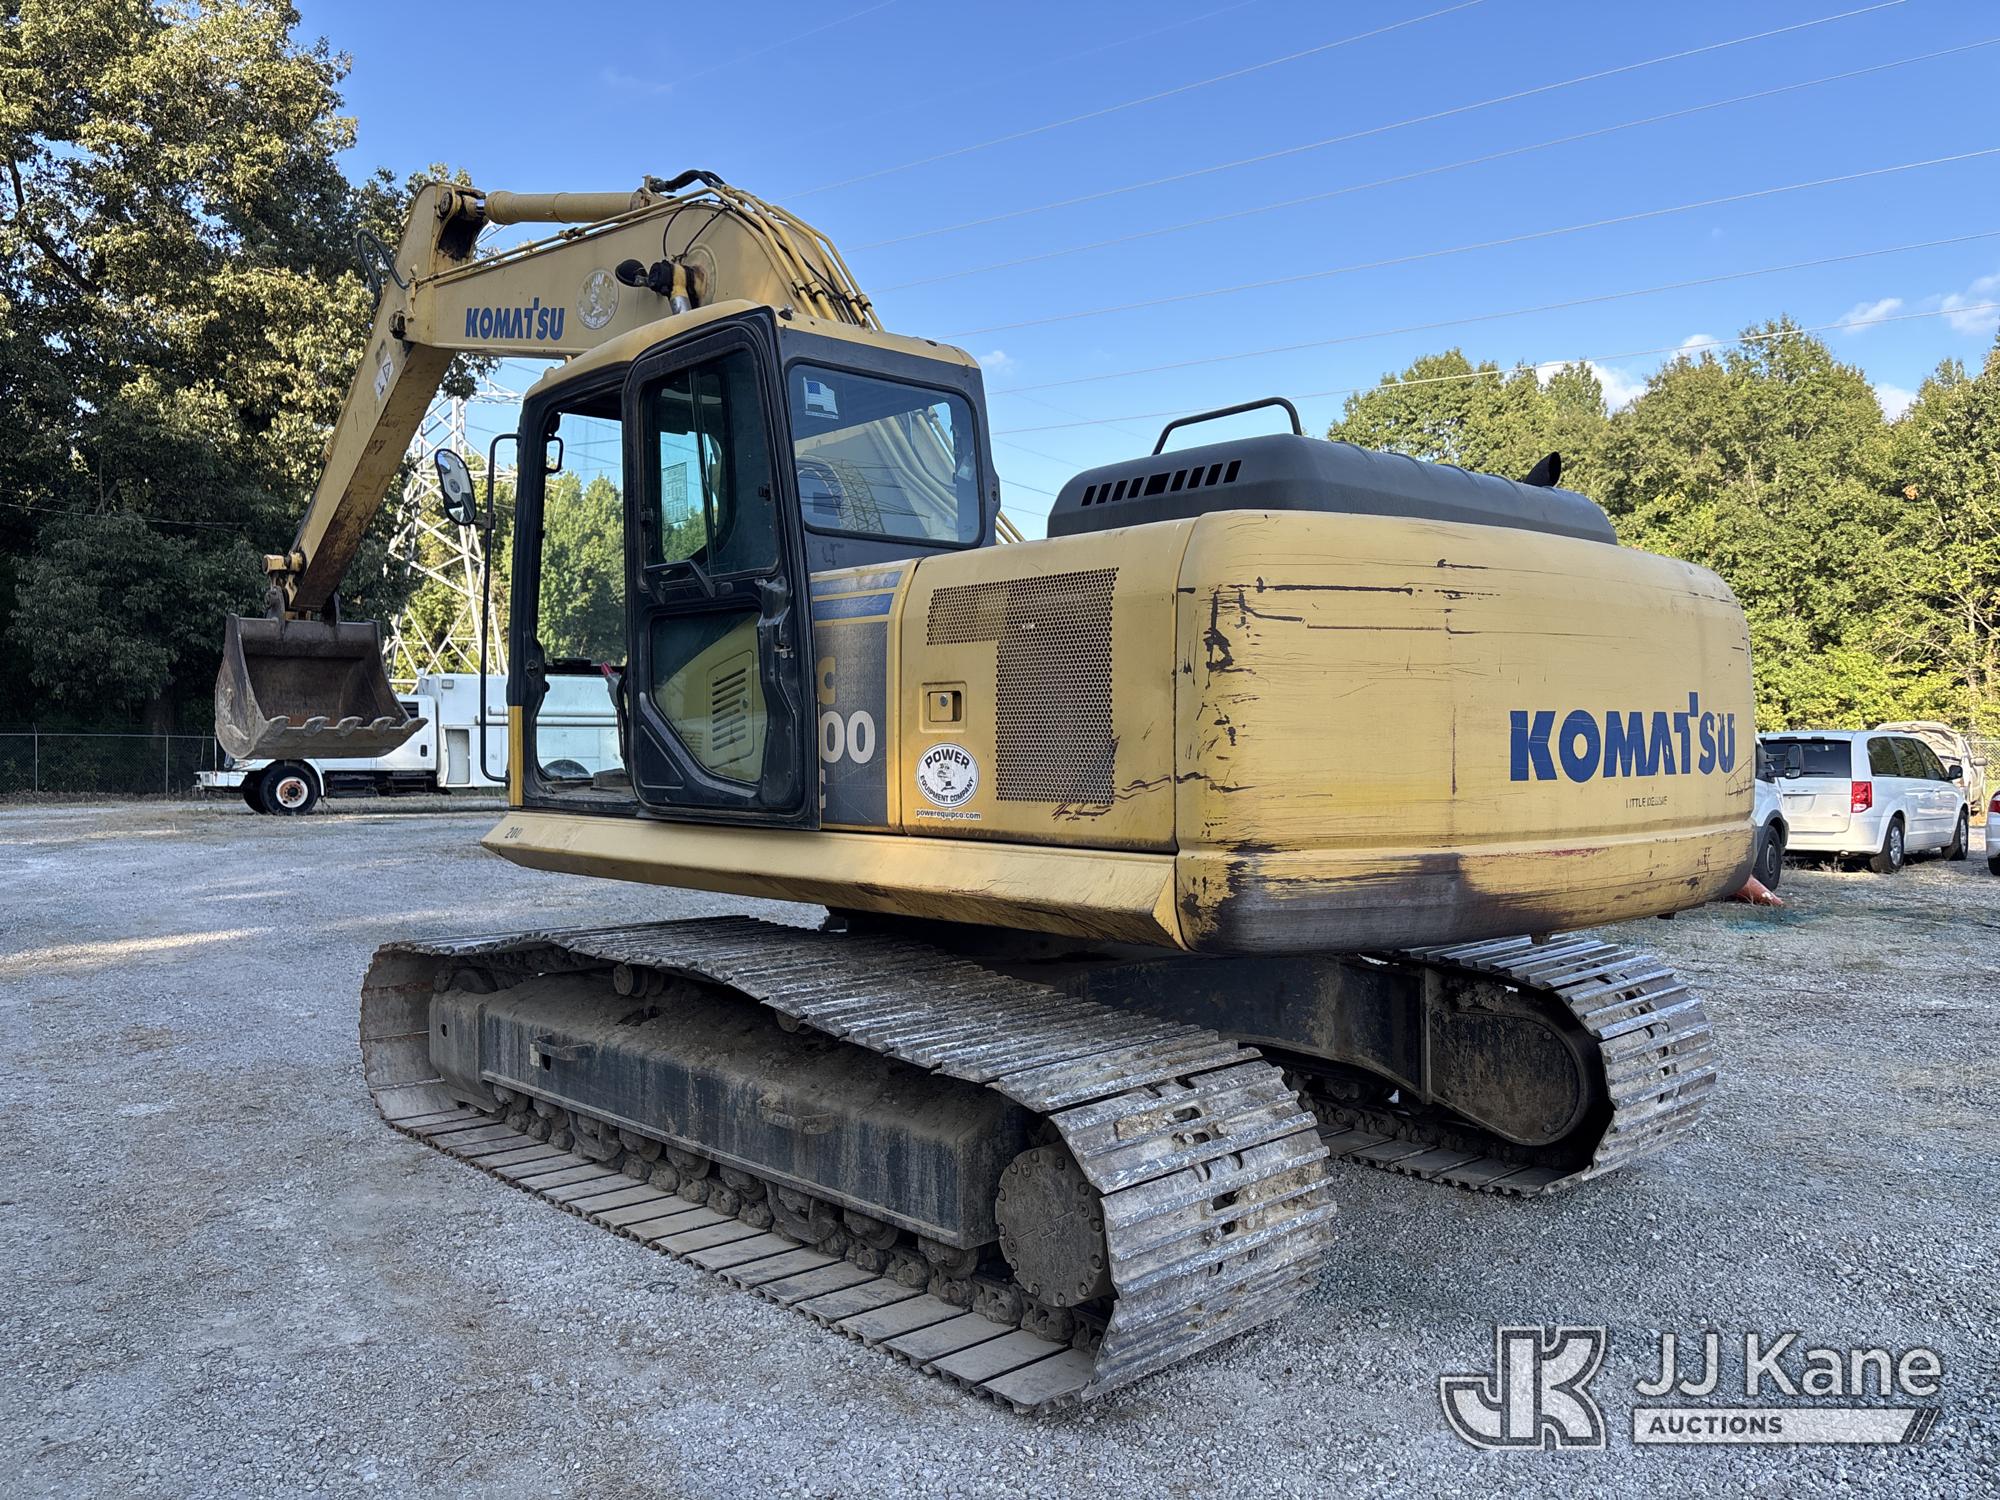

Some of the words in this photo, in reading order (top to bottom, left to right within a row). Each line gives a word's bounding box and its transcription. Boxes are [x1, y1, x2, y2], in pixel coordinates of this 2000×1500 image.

[465, 297, 565, 340] KOMATSU
[1510, 692, 1736, 783] KOMATSU
[925, 748, 970, 770] POWER
[920, 774, 949, 802] EQUIPMENT
[949, 776, 975, 802] COMPANY
[916, 809, 981, 820] powerequipco.com
